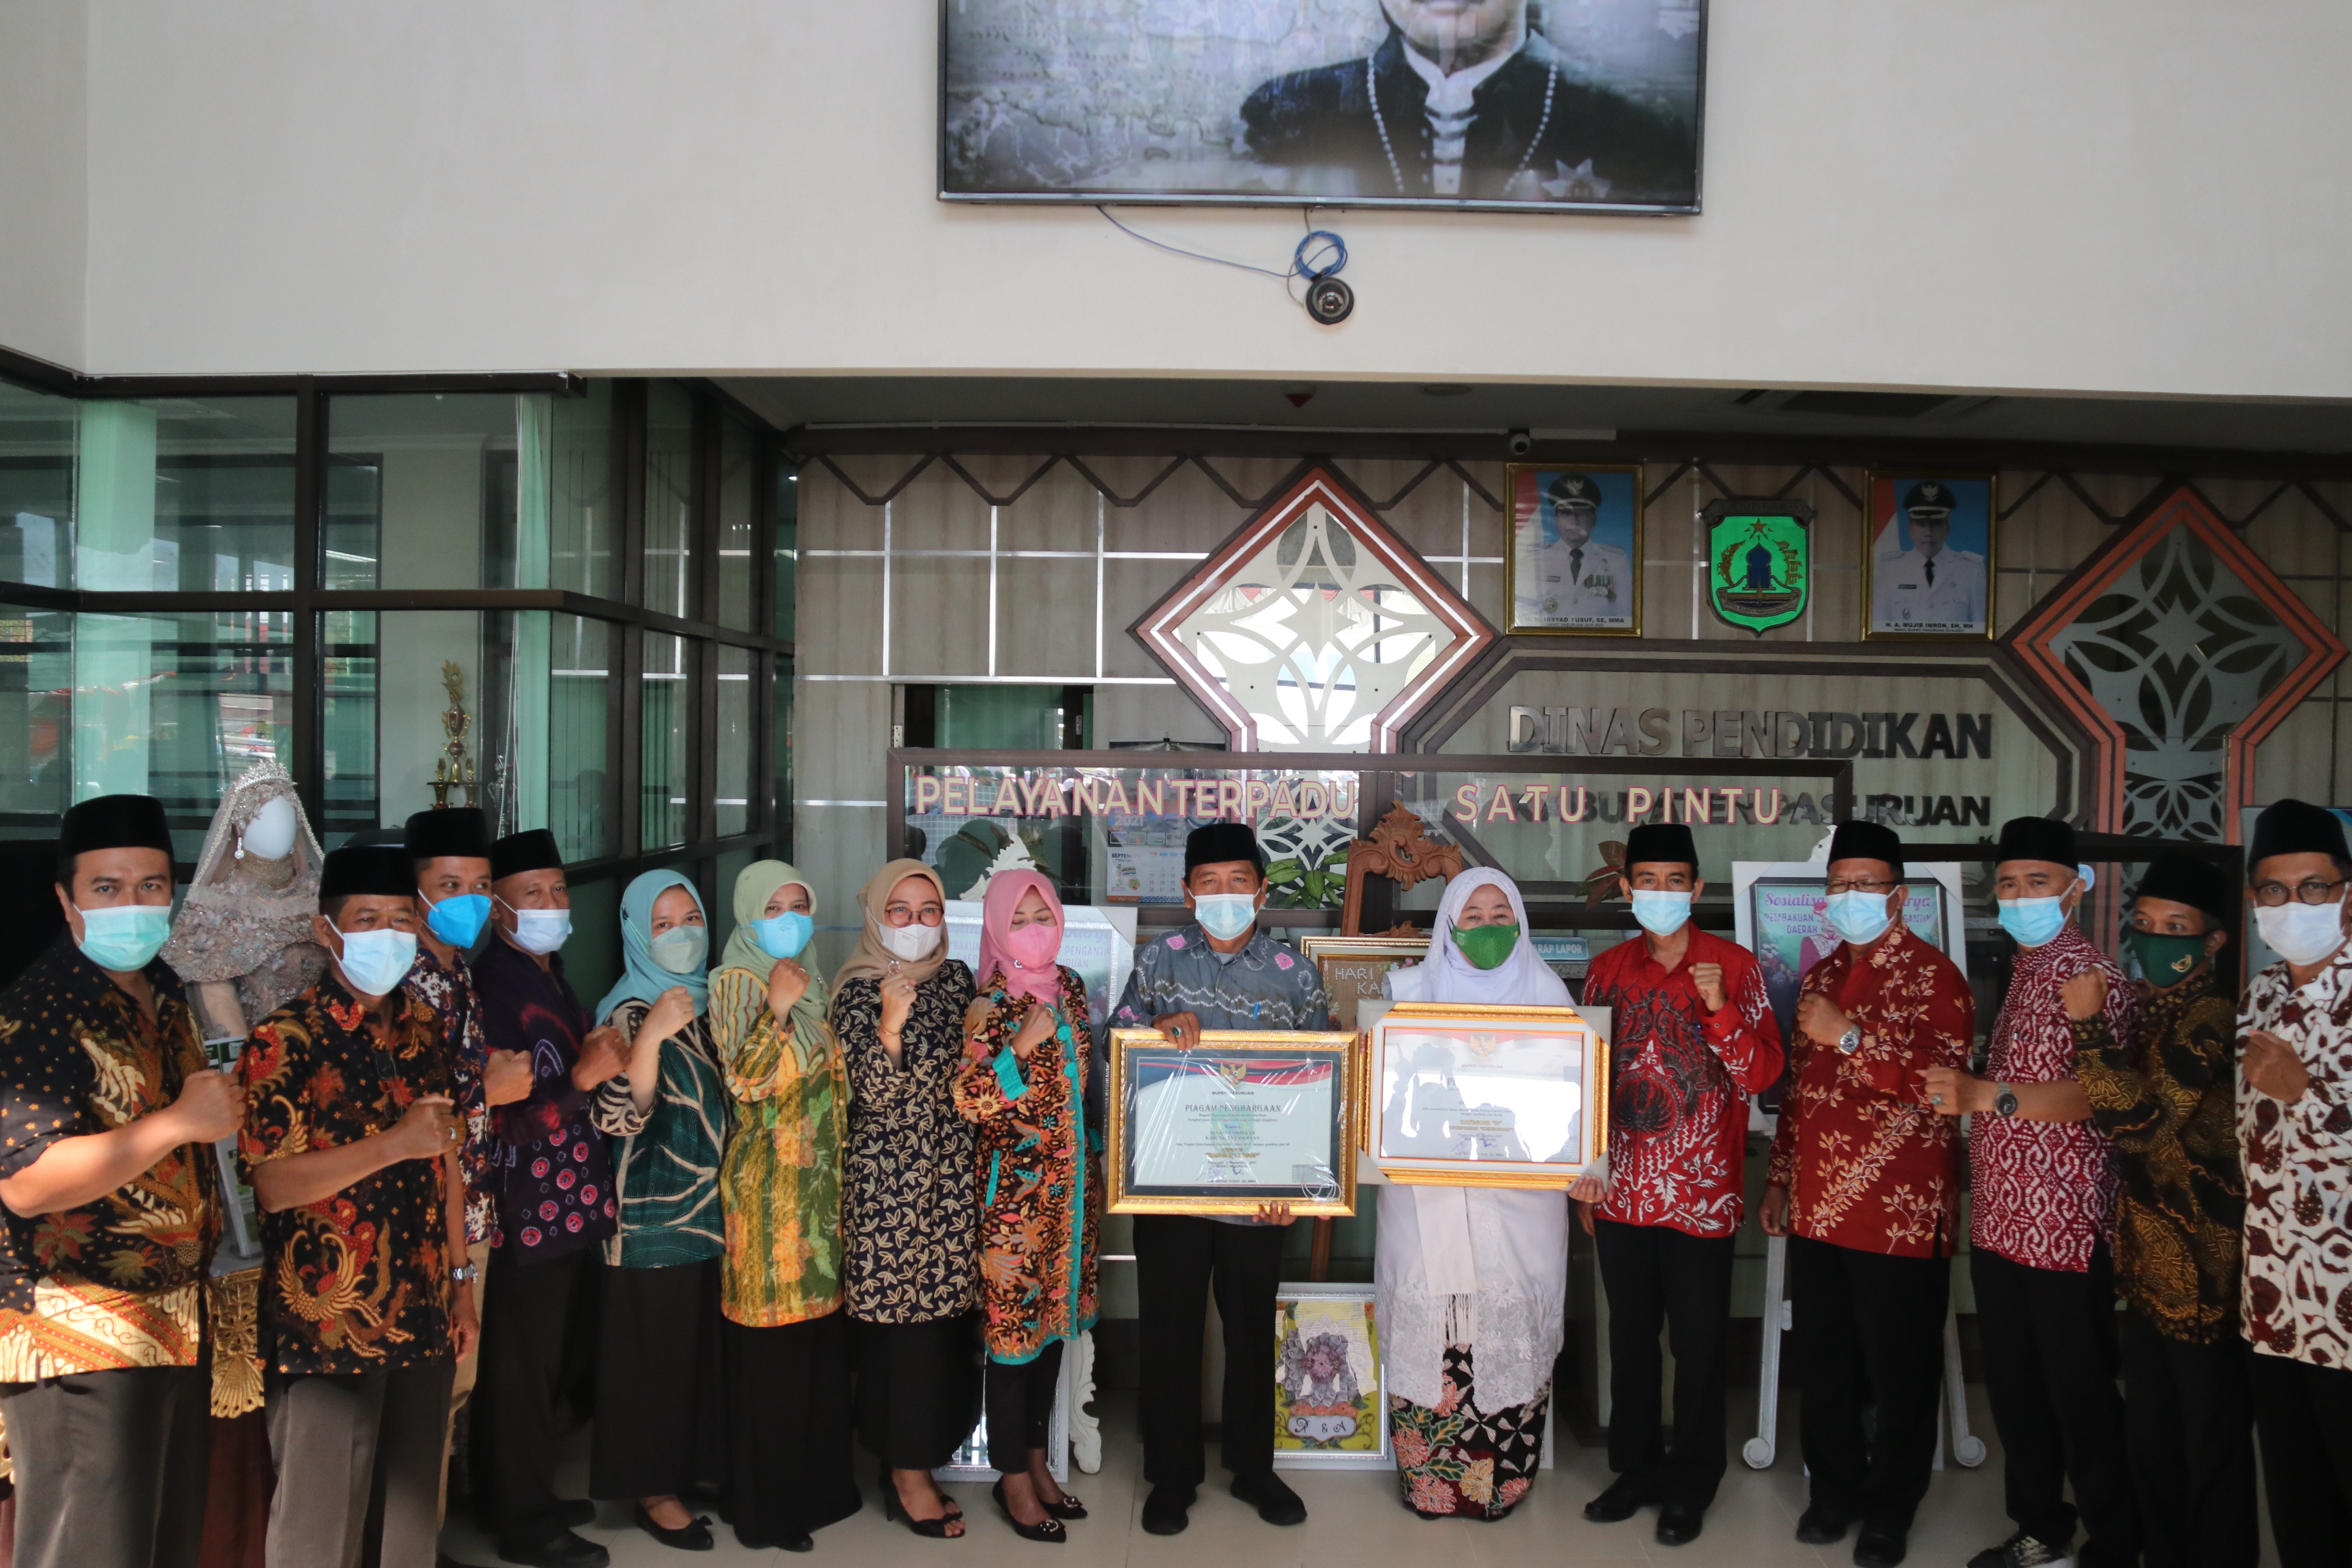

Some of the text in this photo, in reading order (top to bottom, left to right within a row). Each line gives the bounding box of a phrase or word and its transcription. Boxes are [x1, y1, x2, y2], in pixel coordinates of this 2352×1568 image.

[1509, 706, 1992, 760] DINAS PENDIDIKAN
[915, 775, 1781, 824] PELAYANAN TERPADU SATU PINTU
[1114, 815, 1144, 827] 2021
[1786, 924, 1818, 934] DAERAH
[1555, 944, 1583, 954] LAPOR
[1335, 967, 1374, 980] HARI
[1357, 981, 1384, 995] KA
[1219, 1104, 1281, 1113] PENGHARGAAN
[1321, 1423, 1328, 1433] &
